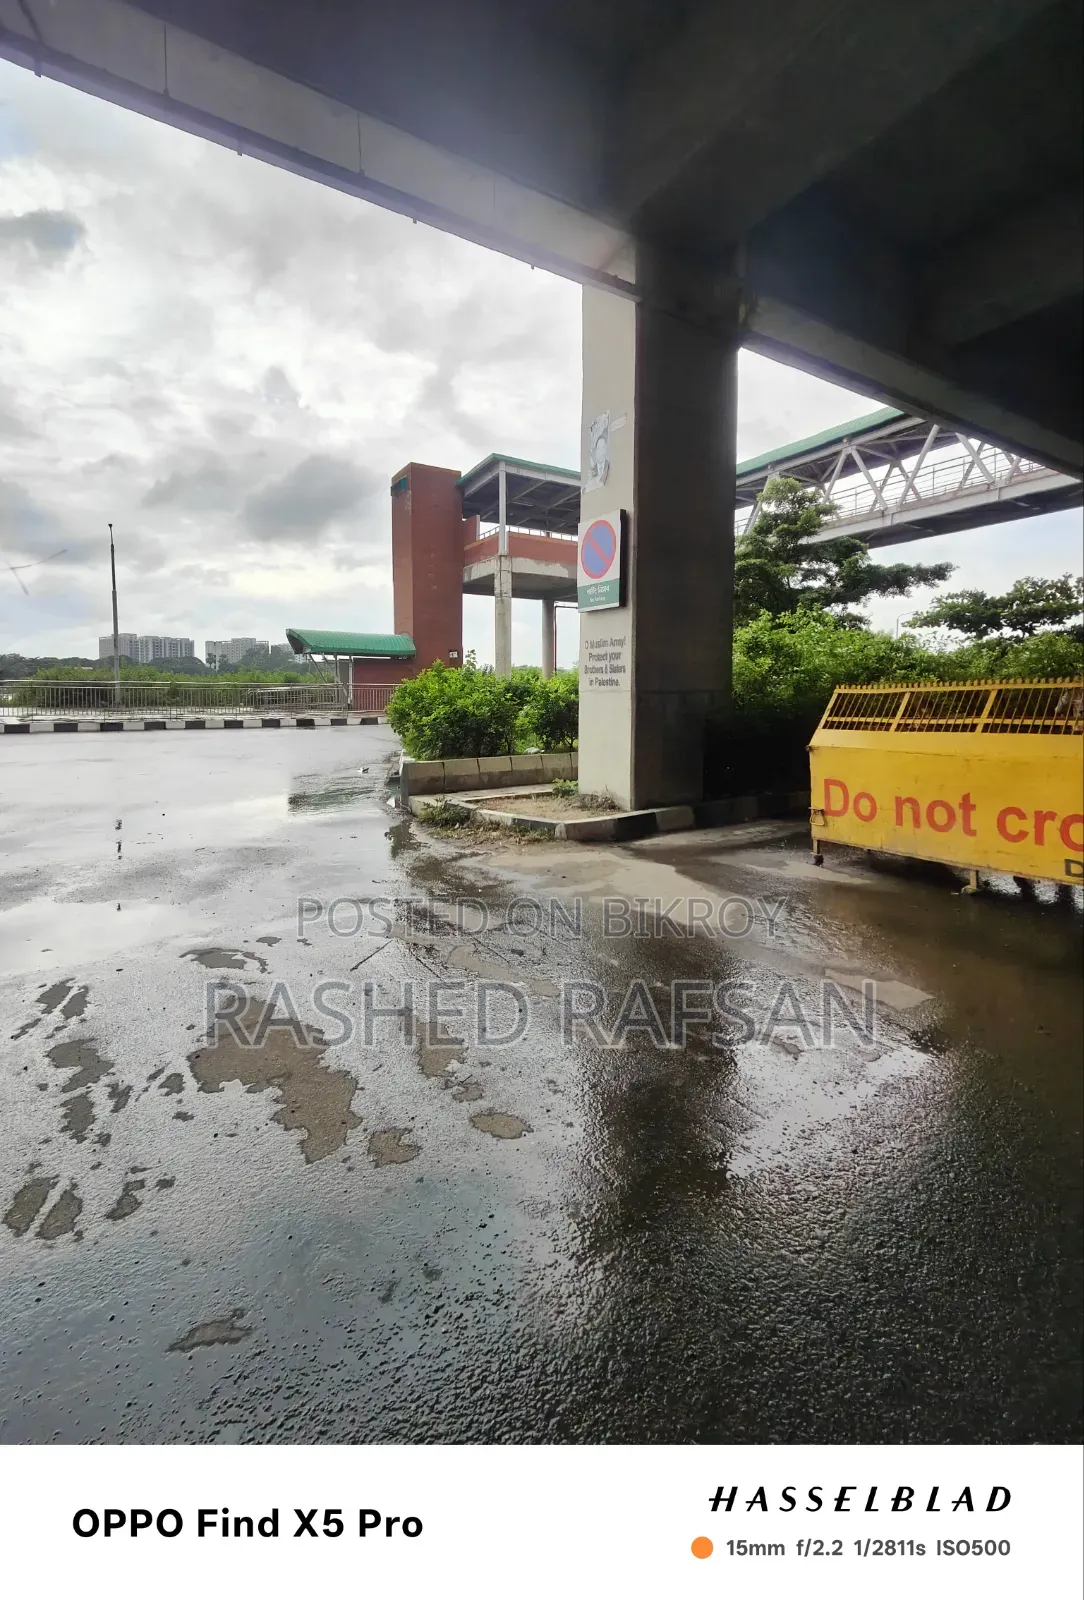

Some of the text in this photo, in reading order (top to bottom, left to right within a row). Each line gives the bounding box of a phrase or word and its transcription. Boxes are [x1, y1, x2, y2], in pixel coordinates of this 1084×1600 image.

[590, 639, 608, 649] Muslim
[589, 652, 621, 663] Protect your
[609, 664, 626, 674] Sisters
[589, 677, 620, 687] in Palestine.
[823, 778, 877, 822] Do
[895, 792, 977, 837] not
